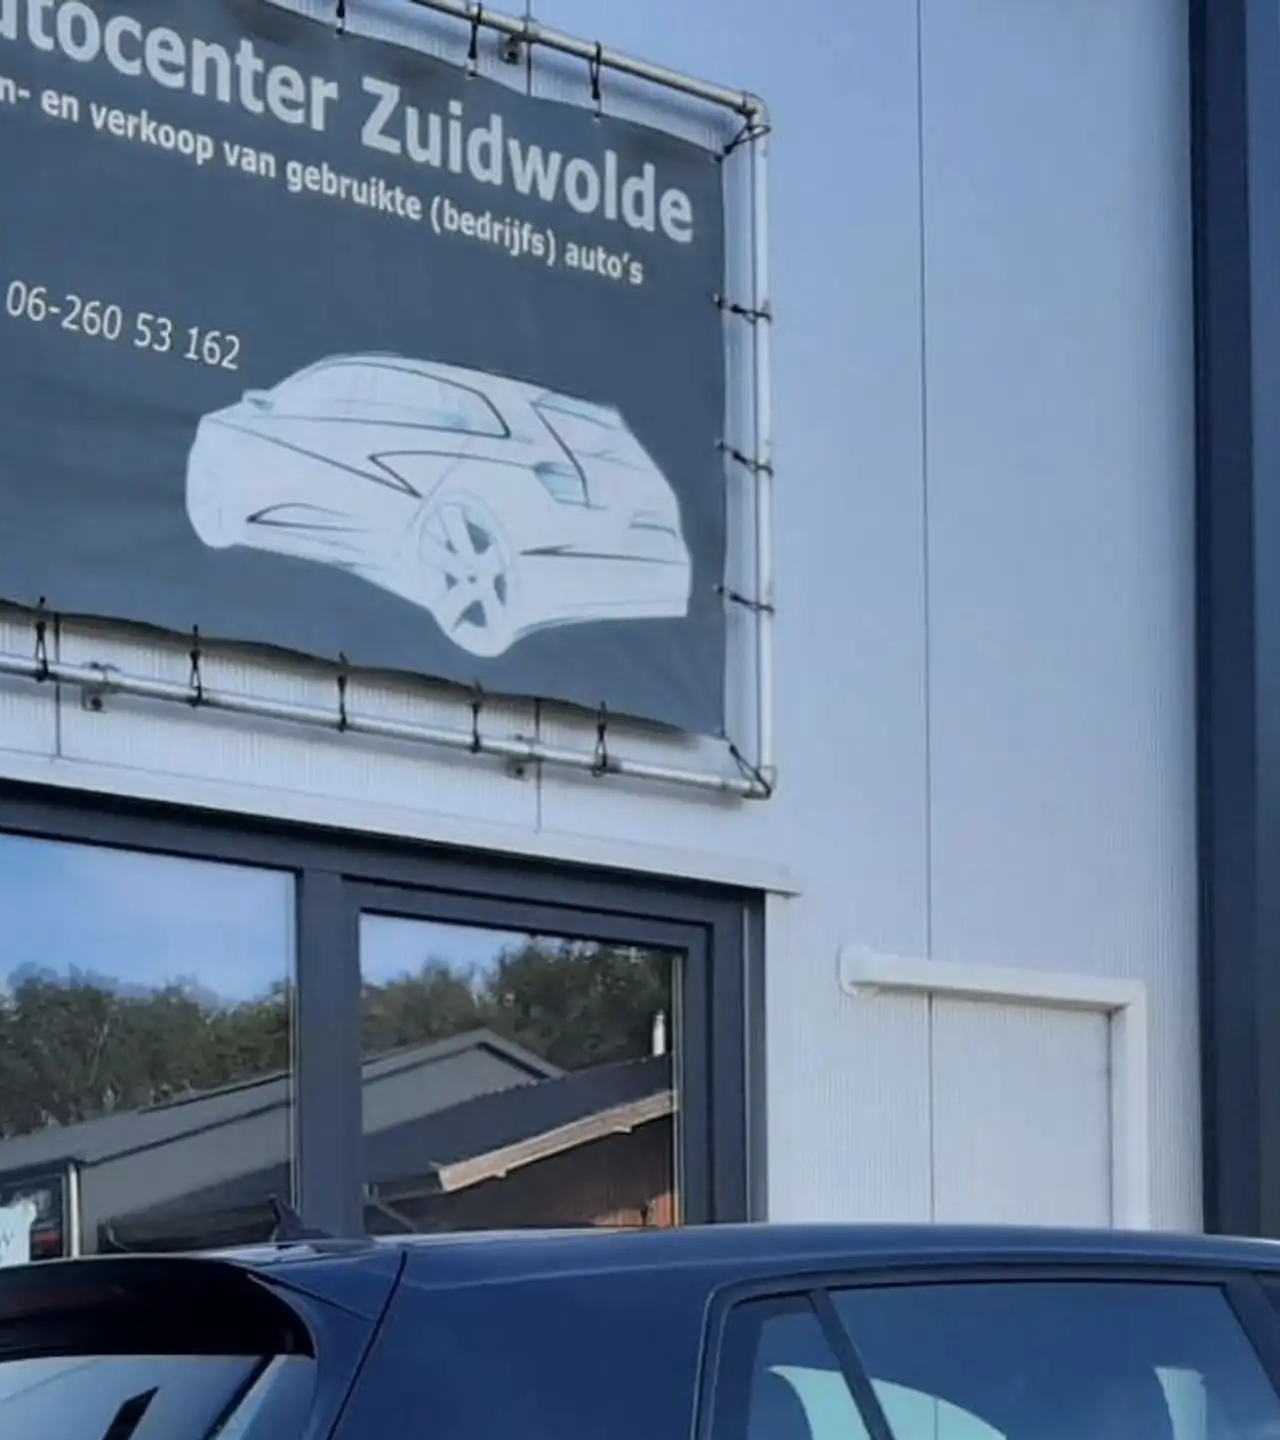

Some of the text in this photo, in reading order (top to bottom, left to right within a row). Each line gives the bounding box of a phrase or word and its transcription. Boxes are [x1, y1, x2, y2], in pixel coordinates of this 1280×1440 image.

[40, 88, 80, 123] en
[89, 102, 215, 166] verkoop
[223, 140, 277, 178] van
[286, 160, 423, 222] gebruikte
[430, 195, 557, 267] (bedrijfs)
[564, 242, 644, 285] auto's
[360, 75, 694, 244] Zuidwolde
[5, 280, 123, 340] 06-260
[133, 312, 173, 352] 53
[183, 326, 241, 370] 162
